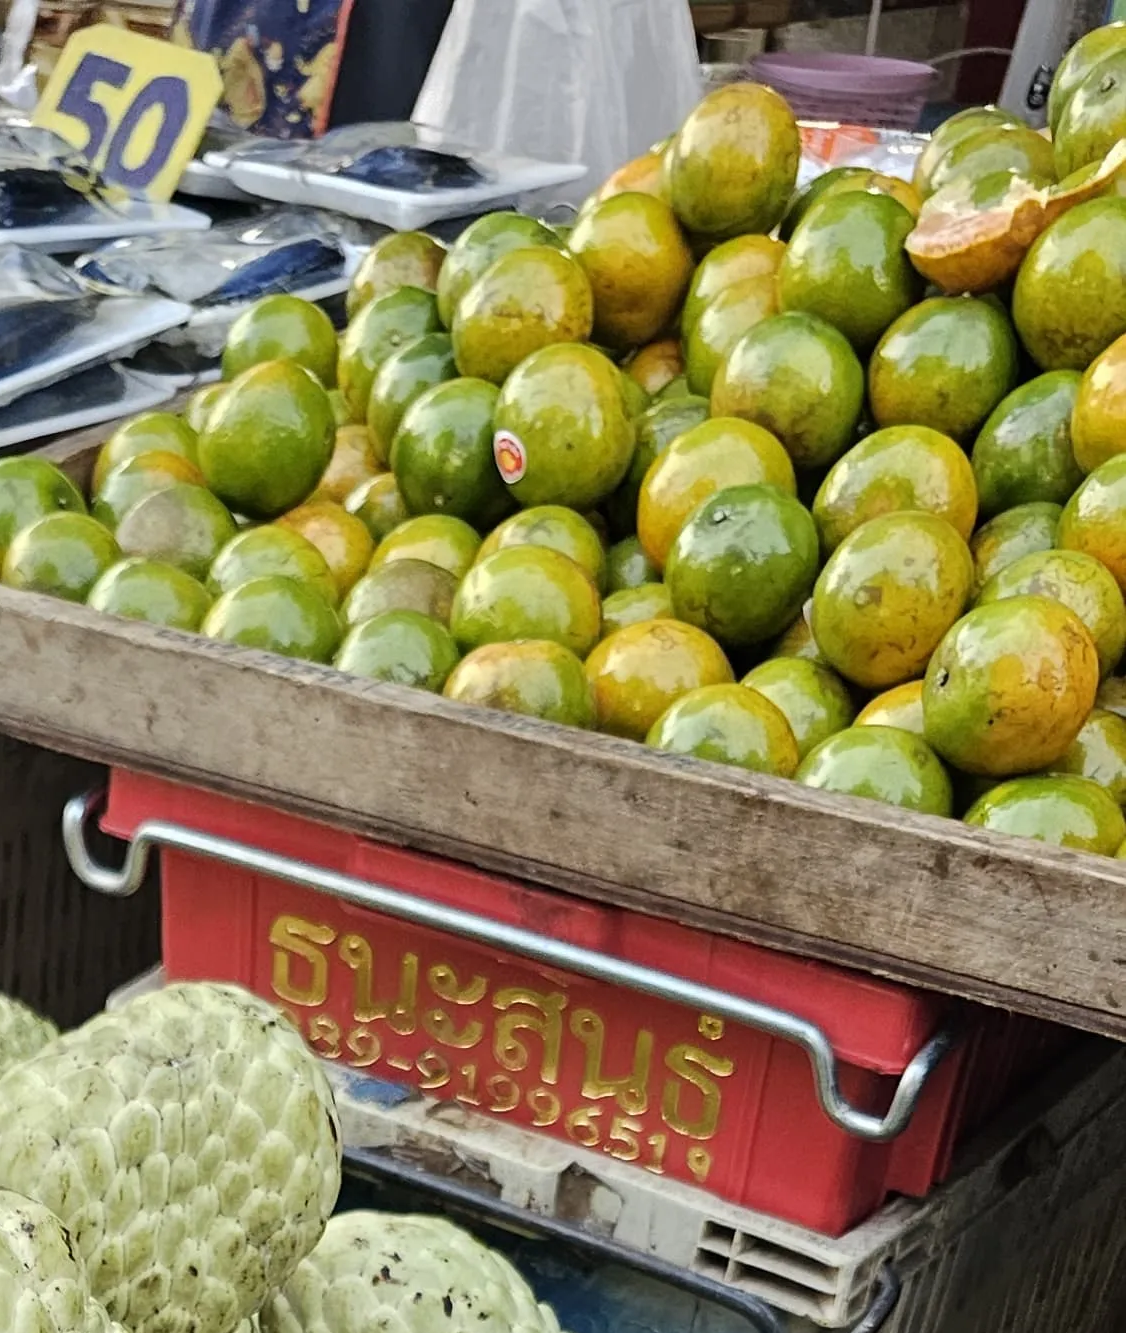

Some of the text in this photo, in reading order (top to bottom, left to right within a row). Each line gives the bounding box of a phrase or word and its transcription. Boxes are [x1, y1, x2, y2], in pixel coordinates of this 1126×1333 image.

[54, 51, 189, 190] 50
[269, 914, 736, 1182] ธนะสนธุ์
